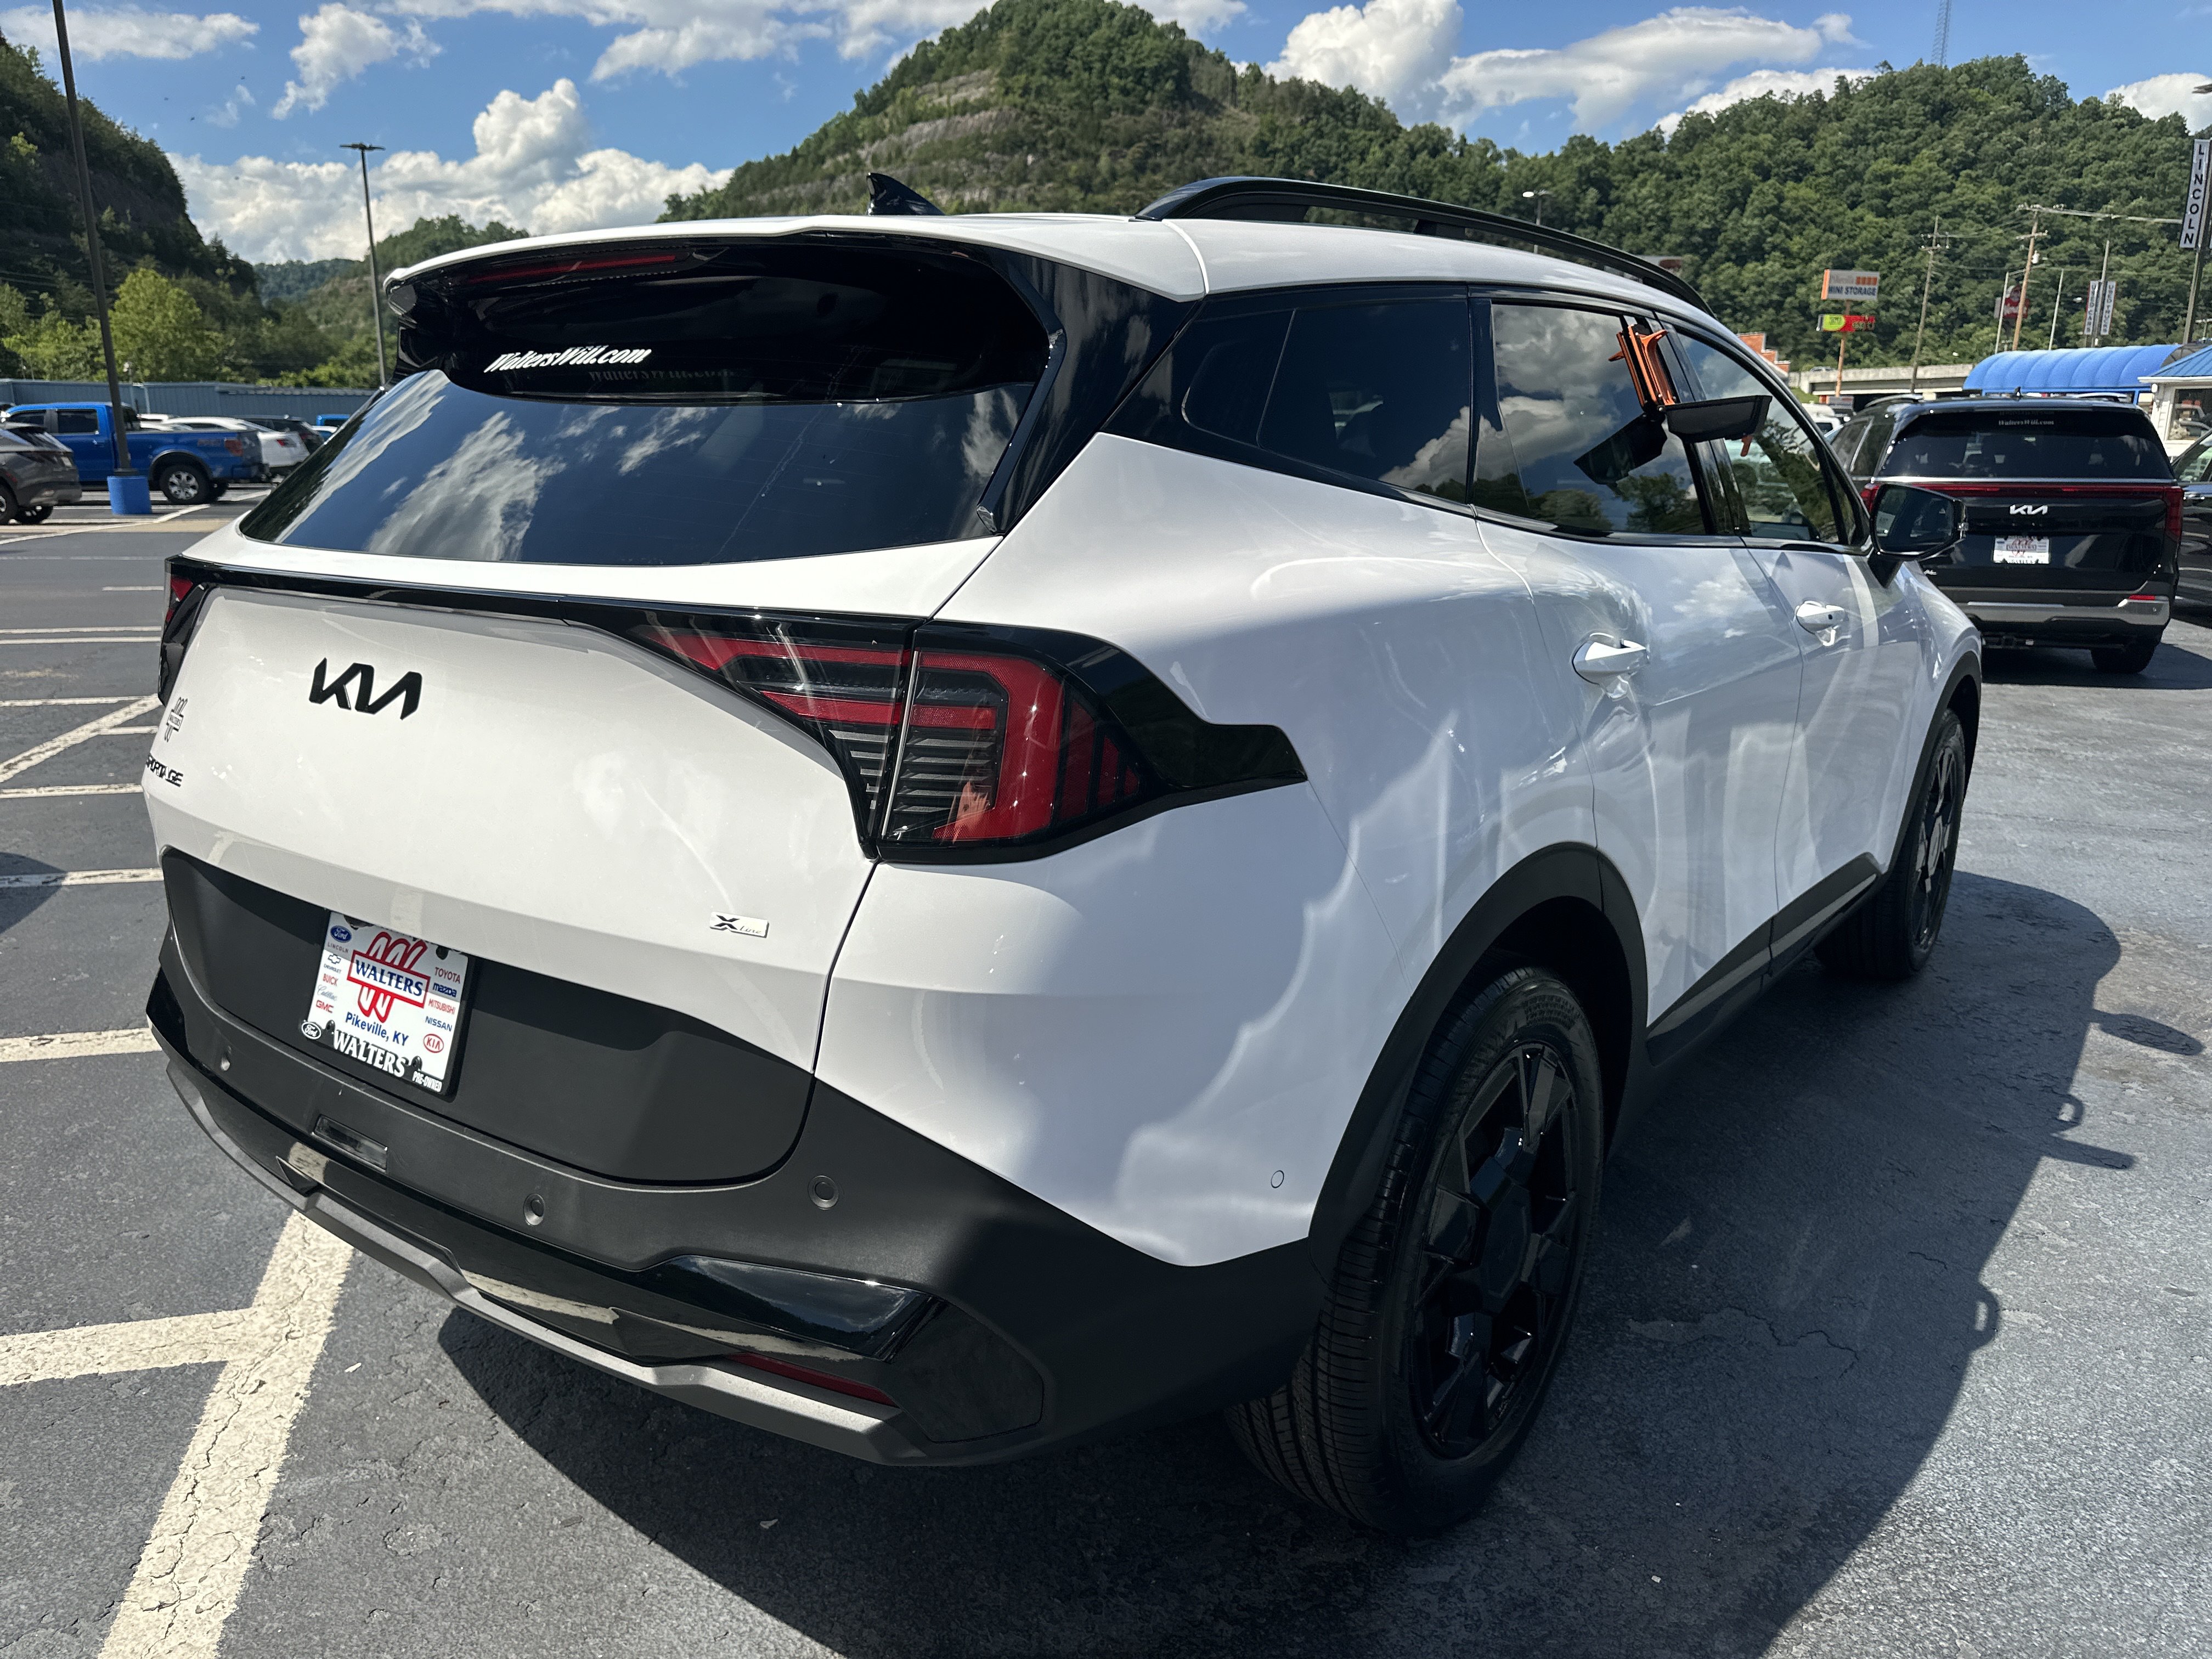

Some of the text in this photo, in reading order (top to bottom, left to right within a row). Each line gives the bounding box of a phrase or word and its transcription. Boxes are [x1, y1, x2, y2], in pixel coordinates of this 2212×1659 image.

[2183, 144, 2204, 244] LINCOLN
[1844, 286, 1876, 296] STORAGE
[484, 345, 652, 373] WaltersWill.com
[2010, 505, 2048, 515] KIA
[309, 658, 422, 720] KIA
[332, 927, 350, 941] Ford
[327, 942, 348, 953] LINCOLN
[324, 963, 342, 974] CHEVROLET
[435, 967, 460, 984] TOYOTA
[323, 973, 338, 986] BUICK
[356, 959, 423, 997] WALTERS
[317, 984, 338, 1001] Cadillac
[315, 1000, 334, 1013] GMC
[428, 998, 455, 1015] MITSUBISHI
[303, 1023, 320, 1039] Ford
[346, 1012, 409, 1046] Pikeville, KY
[425, 1016, 453, 1031] NISSAN
[425, 1036, 442, 1051] KIA
[333, 1029, 405, 1077] WALTERS
[412, 1070, 442, 1092] PRE-OWNED
